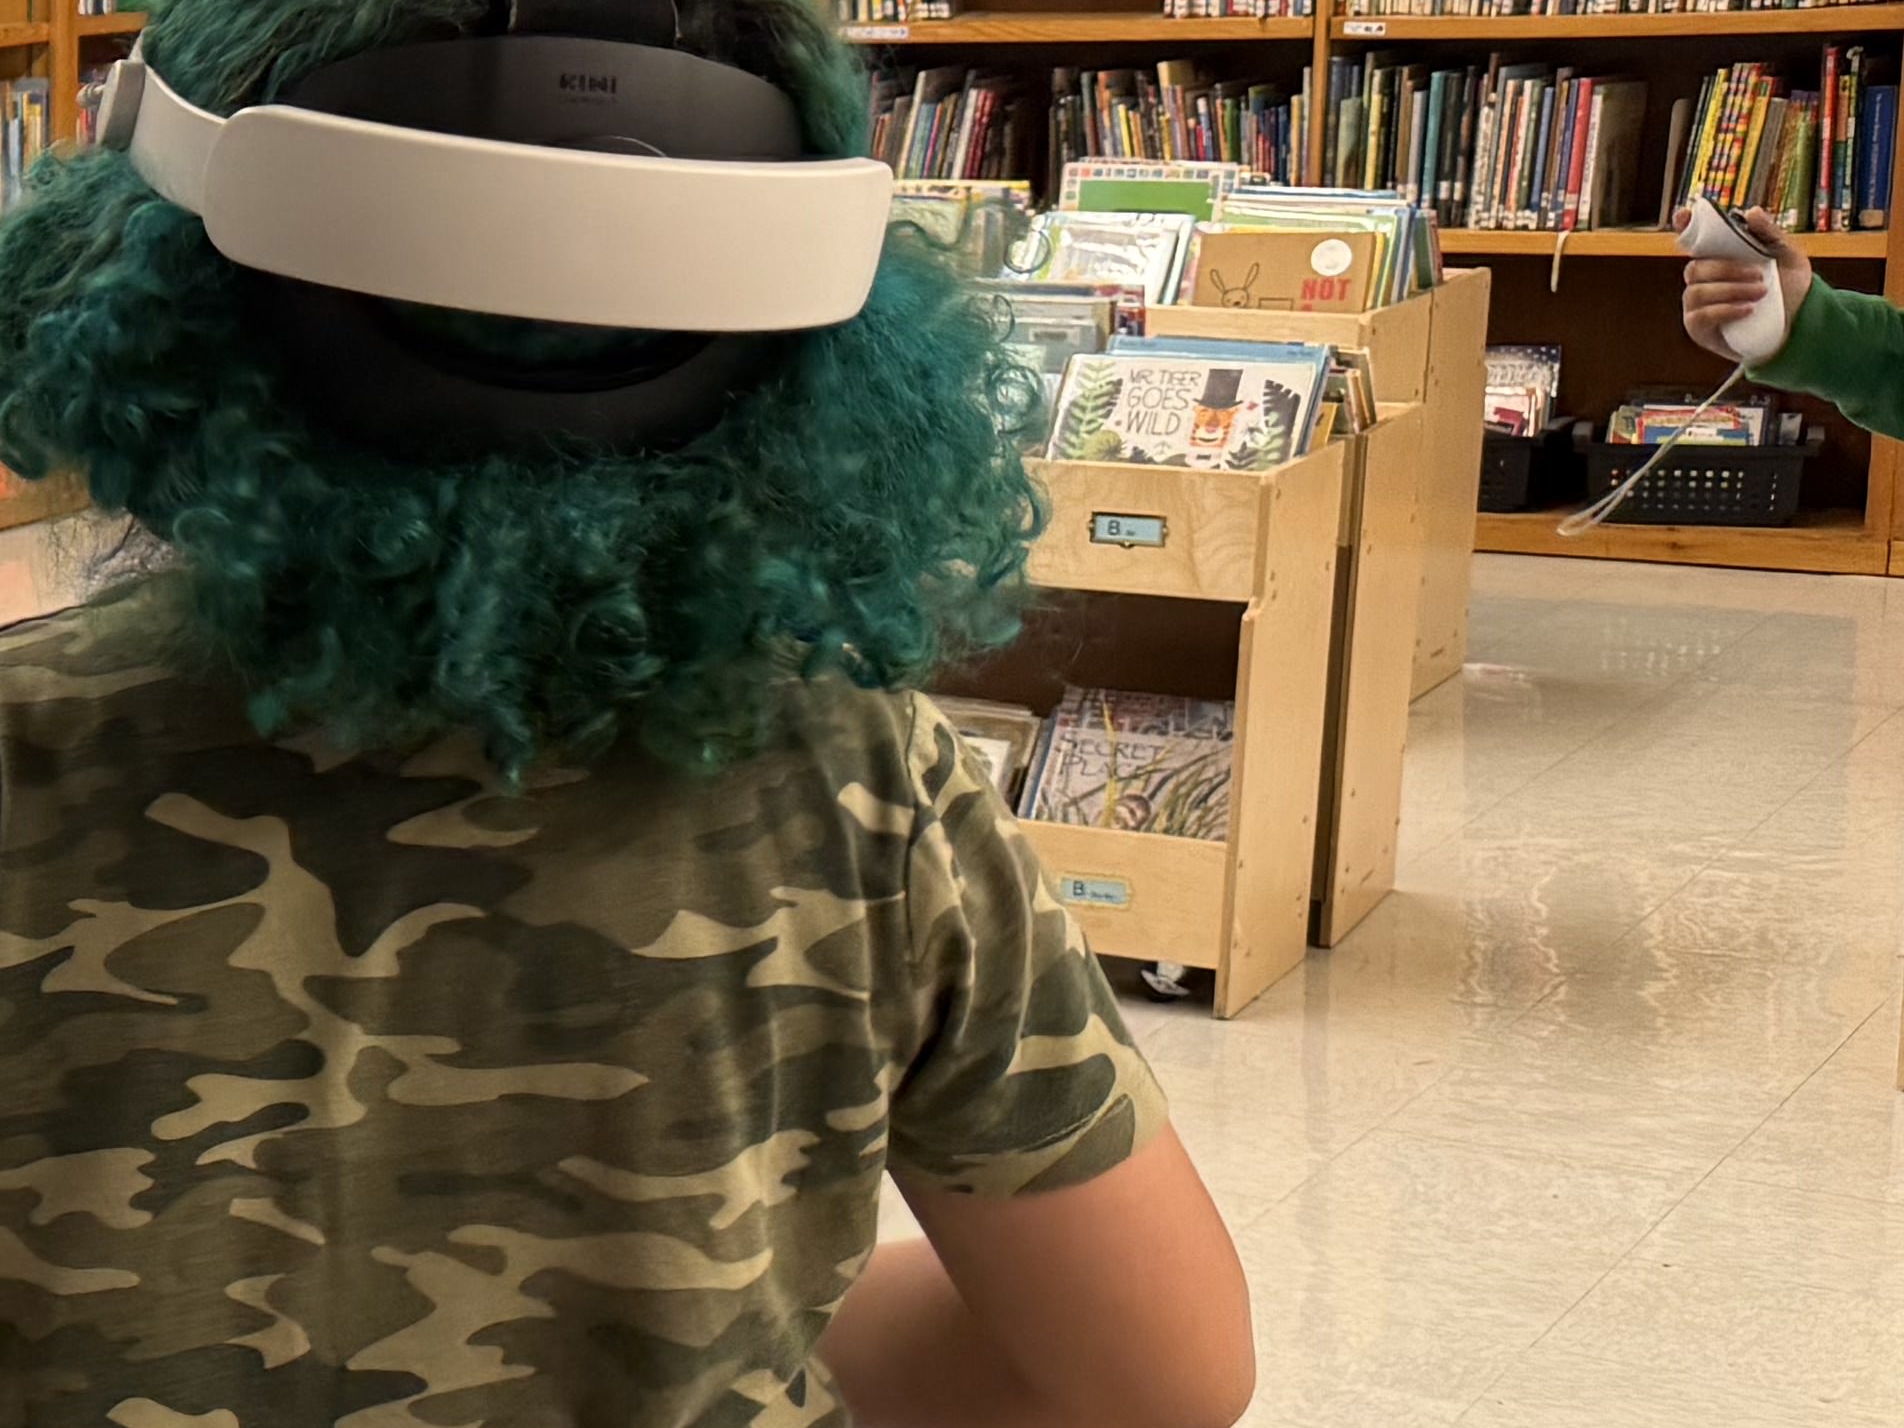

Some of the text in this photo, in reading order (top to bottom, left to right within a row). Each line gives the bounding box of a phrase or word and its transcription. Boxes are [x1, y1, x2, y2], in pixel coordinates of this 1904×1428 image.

[1301, 276, 1352, 301] NOT
[1159, 369, 1202, 387] TIGER
[1127, 385, 1192, 411] GOES
[1126, 409, 1181, 436] WILD
[1073, 880, 1085, 896] B
